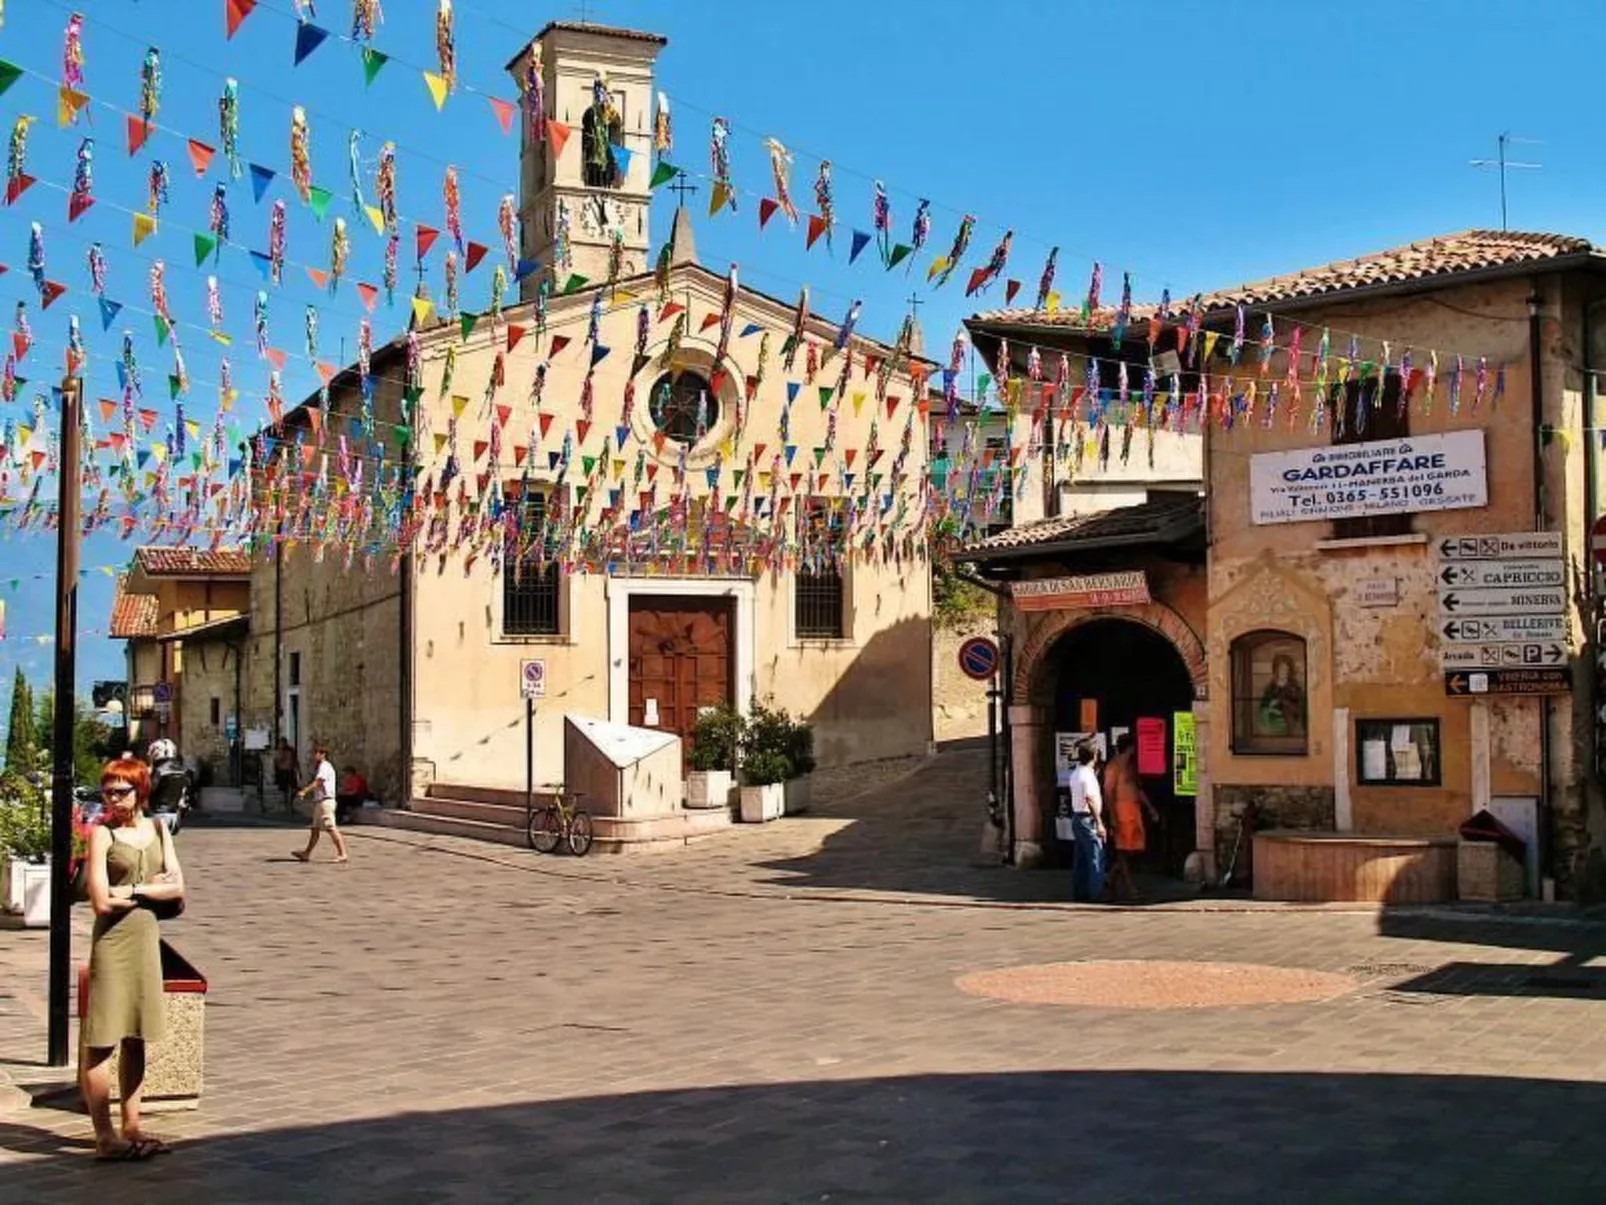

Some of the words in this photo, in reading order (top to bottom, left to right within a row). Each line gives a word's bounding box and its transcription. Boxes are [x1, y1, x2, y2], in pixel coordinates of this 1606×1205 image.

[1283, 453, 1446, 482] GARDAFFARE
[1427, 469, 1471, 480] GARDA
[1288, 493, 1322, 507] Tel.
[1483, 571, 1561, 583] CAPRICCIO
[1511, 594, 1561, 605] MINERVA
[1503, 618, 1562, 630] BELLERIVE
